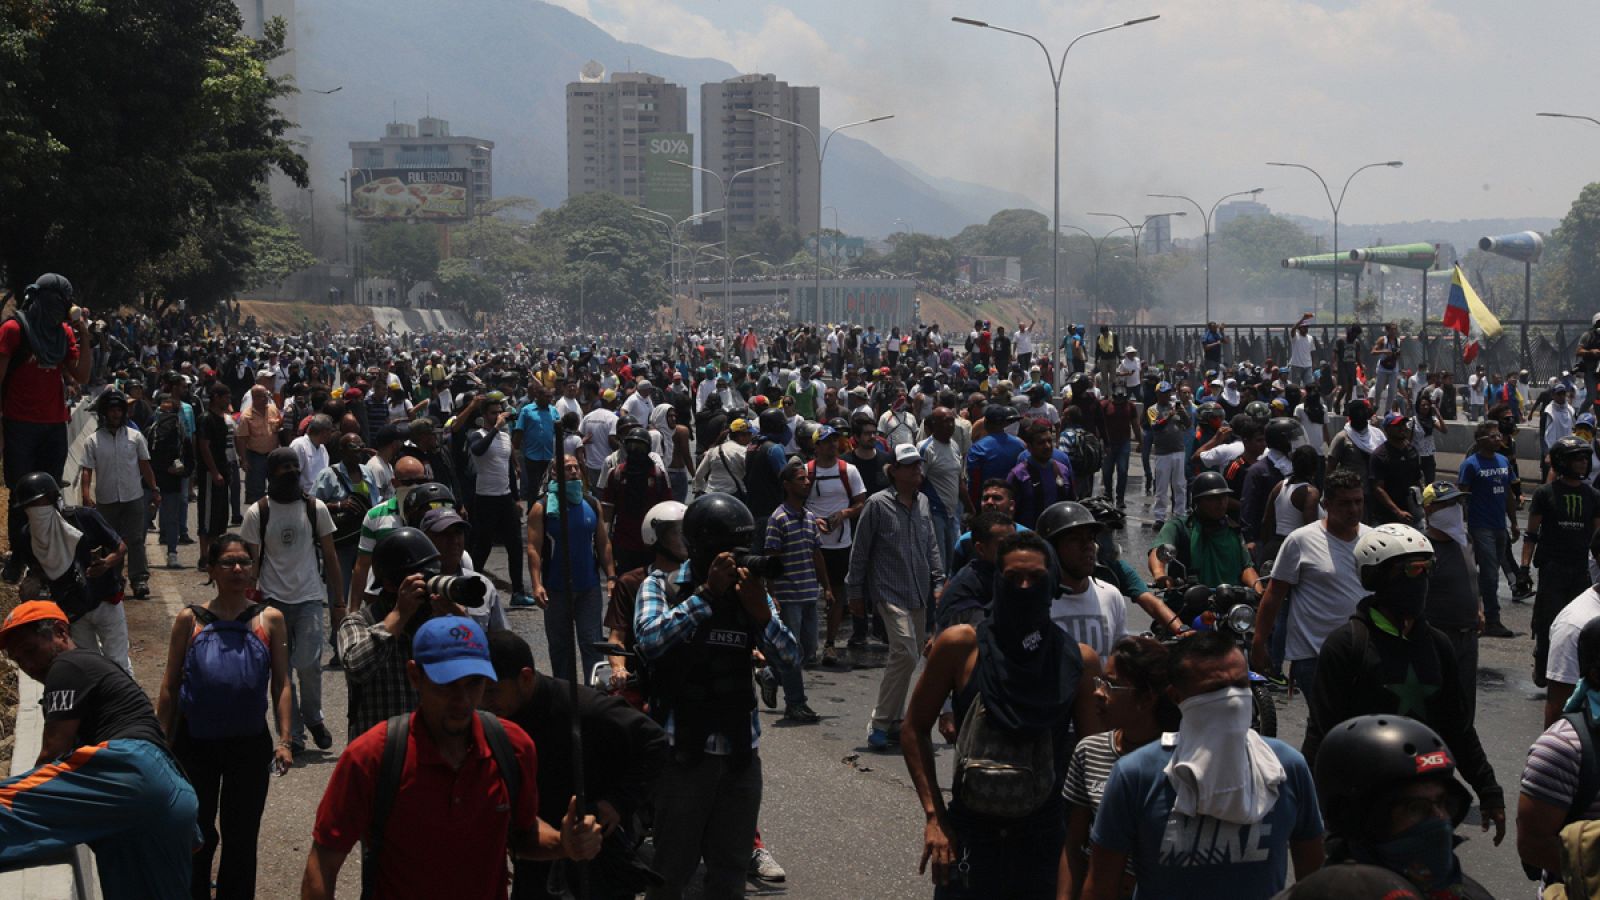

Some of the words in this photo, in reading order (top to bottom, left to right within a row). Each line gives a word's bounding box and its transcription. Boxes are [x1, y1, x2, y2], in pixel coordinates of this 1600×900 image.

[650, 139, 689, 155] SOYA
[407, 171, 426, 183] FULL
[709, 631, 743, 644] ENSA
[1420, 755, 1444, 767] XG
[1159, 812, 1273, 866] NIKE
